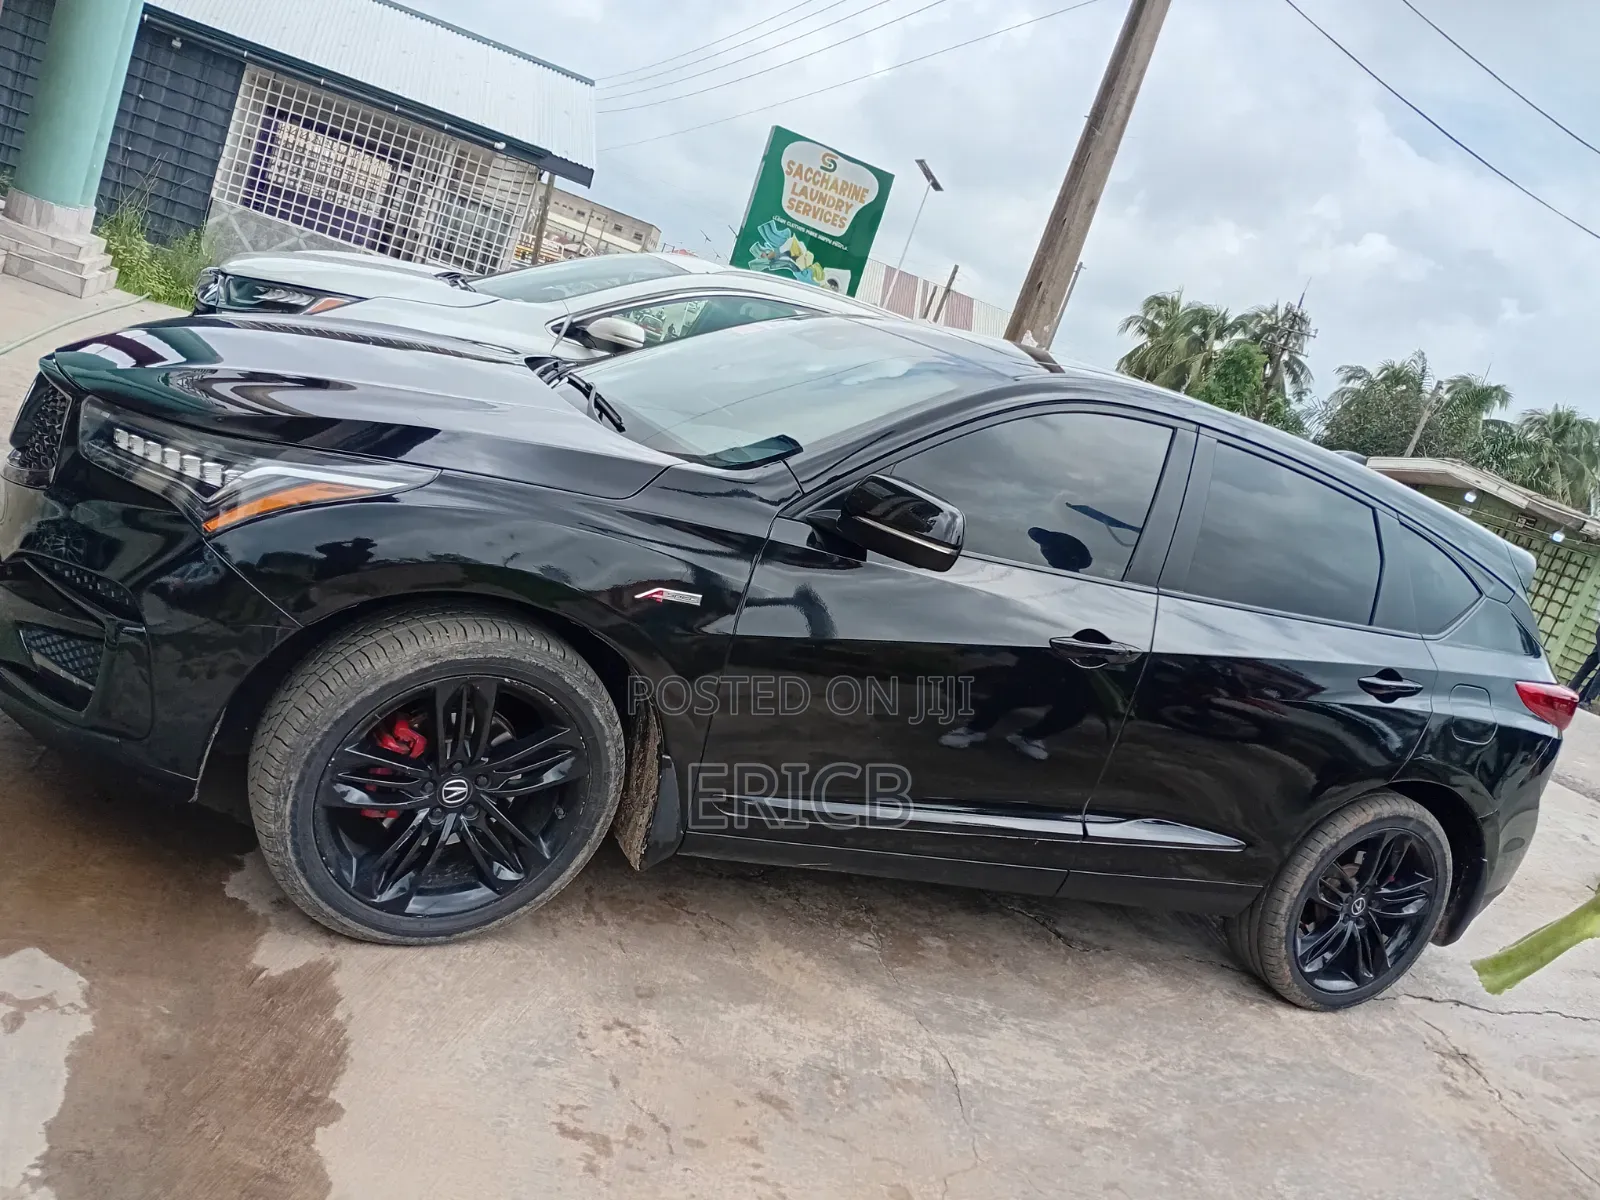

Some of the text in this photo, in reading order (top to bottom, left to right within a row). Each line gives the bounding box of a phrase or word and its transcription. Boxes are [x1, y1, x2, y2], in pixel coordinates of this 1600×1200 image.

[785, 159, 869, 204] SACCHARINE
[791, 181, 854, 215] LAUNDRY
[787, 198, 848, 229] SERVICES
